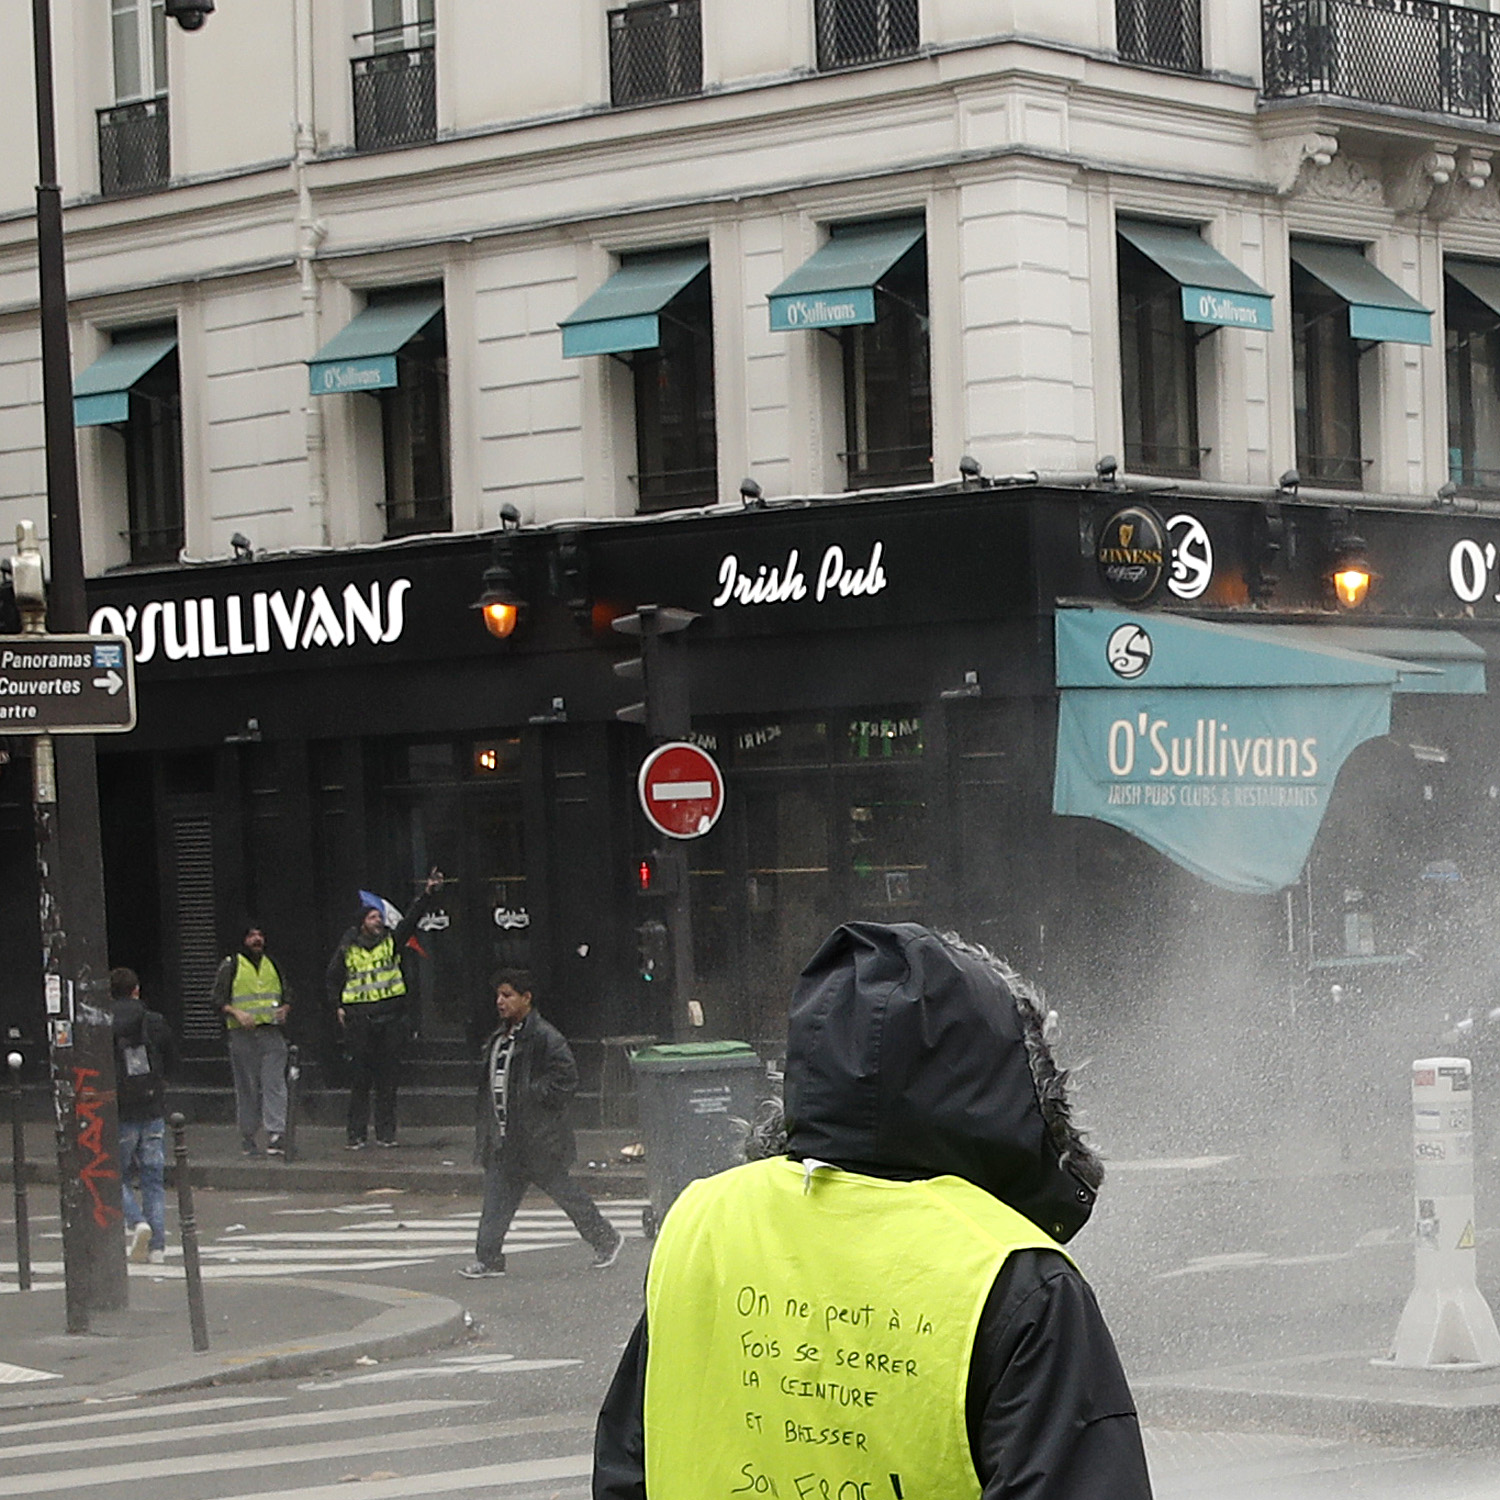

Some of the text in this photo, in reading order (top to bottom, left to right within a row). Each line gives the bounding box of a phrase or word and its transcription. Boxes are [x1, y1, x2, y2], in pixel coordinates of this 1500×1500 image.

[713, 541, 887, 607] Irish Pub
[2, 650, 92, 669] Panoramas
[0, 677, 81, 695] Couvertes
[1108, 712, 1318, 777] O'Sullivans
[1108, 785, 1141, 805] IRISH
[1144, 785, 1176, 806] PUBS
[737, 1286, 770, 1317] On
[785, 1299, 809, 1318] ne
[825, 1304, 875, 1332] peut
[741, 1330, 781, 1359] Fois
[743, 1370, 878, 1407] LA CEINTURE
[746, 1412, 762, 1434] ET
